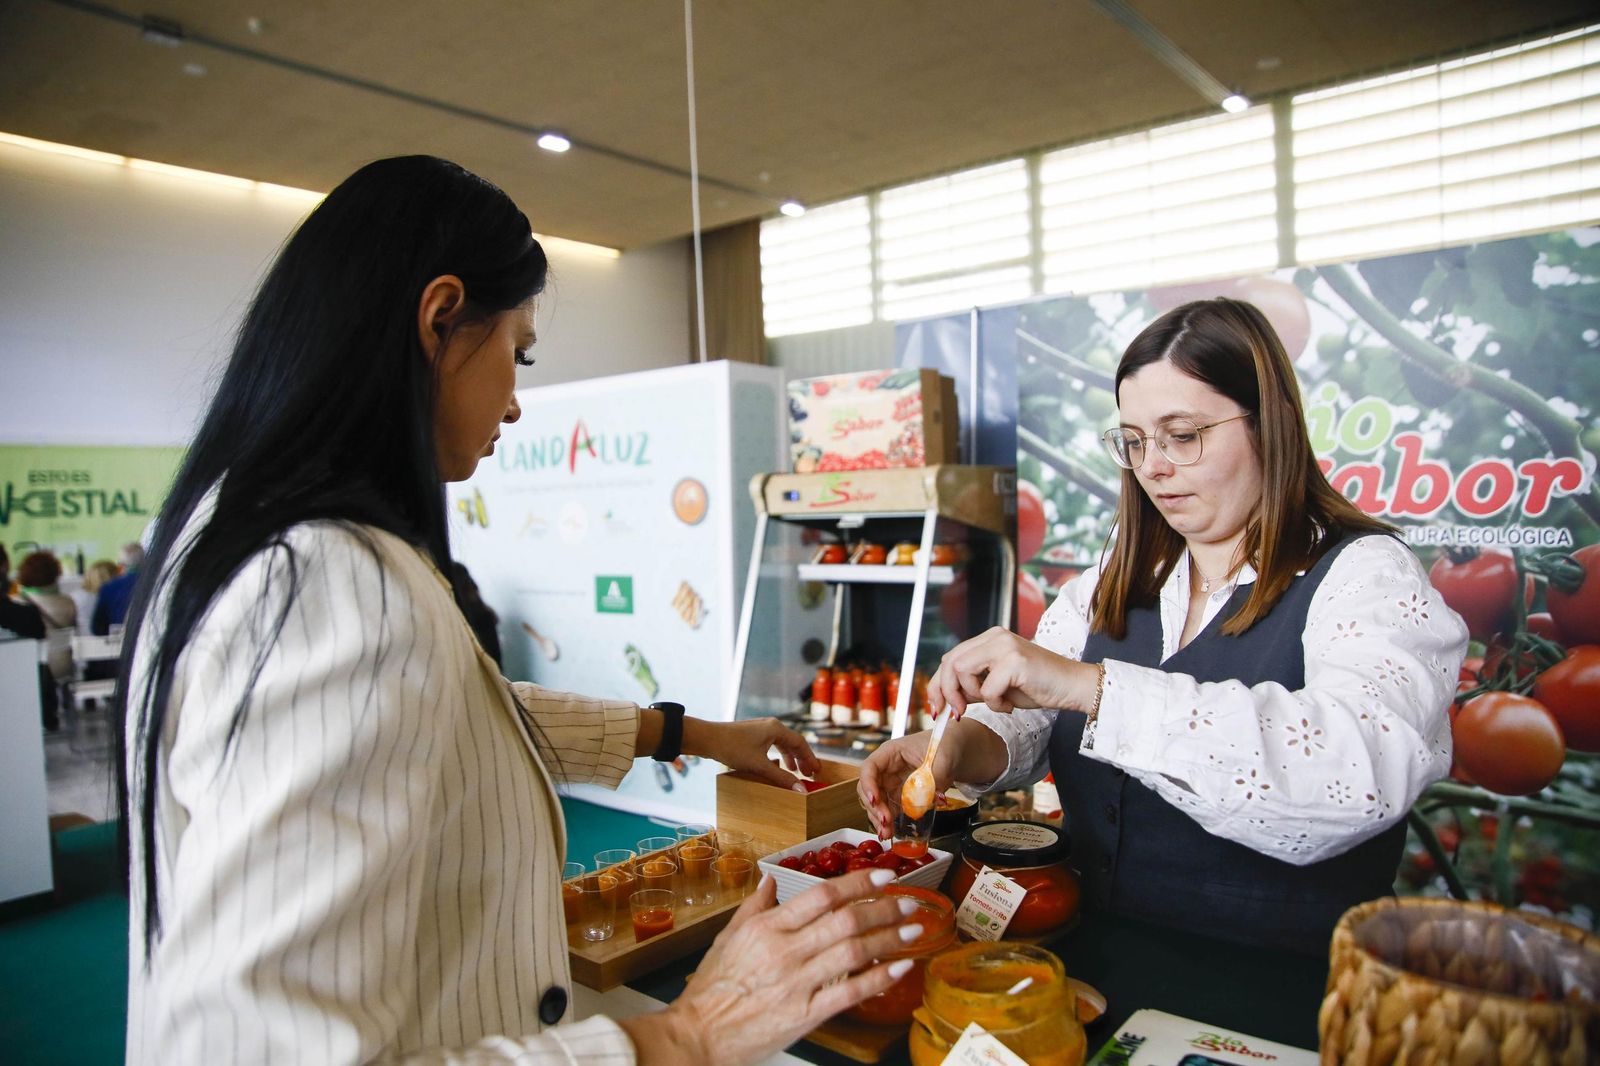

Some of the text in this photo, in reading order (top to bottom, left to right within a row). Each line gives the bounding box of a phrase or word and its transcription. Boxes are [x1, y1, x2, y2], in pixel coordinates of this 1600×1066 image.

[1307, 382, 1393, 454] io
[499, 416, 652, 474] LANDALUZ
[1317, 431, 1584, 517] abor
[1405, 523, 1571, 546] TURA ECOLÓGICA
[969, 893, 993, 912] Tomate
[979, 883, 1013, 909] Fusiona
[1191, 1039, 1278, 1060] Sabor
